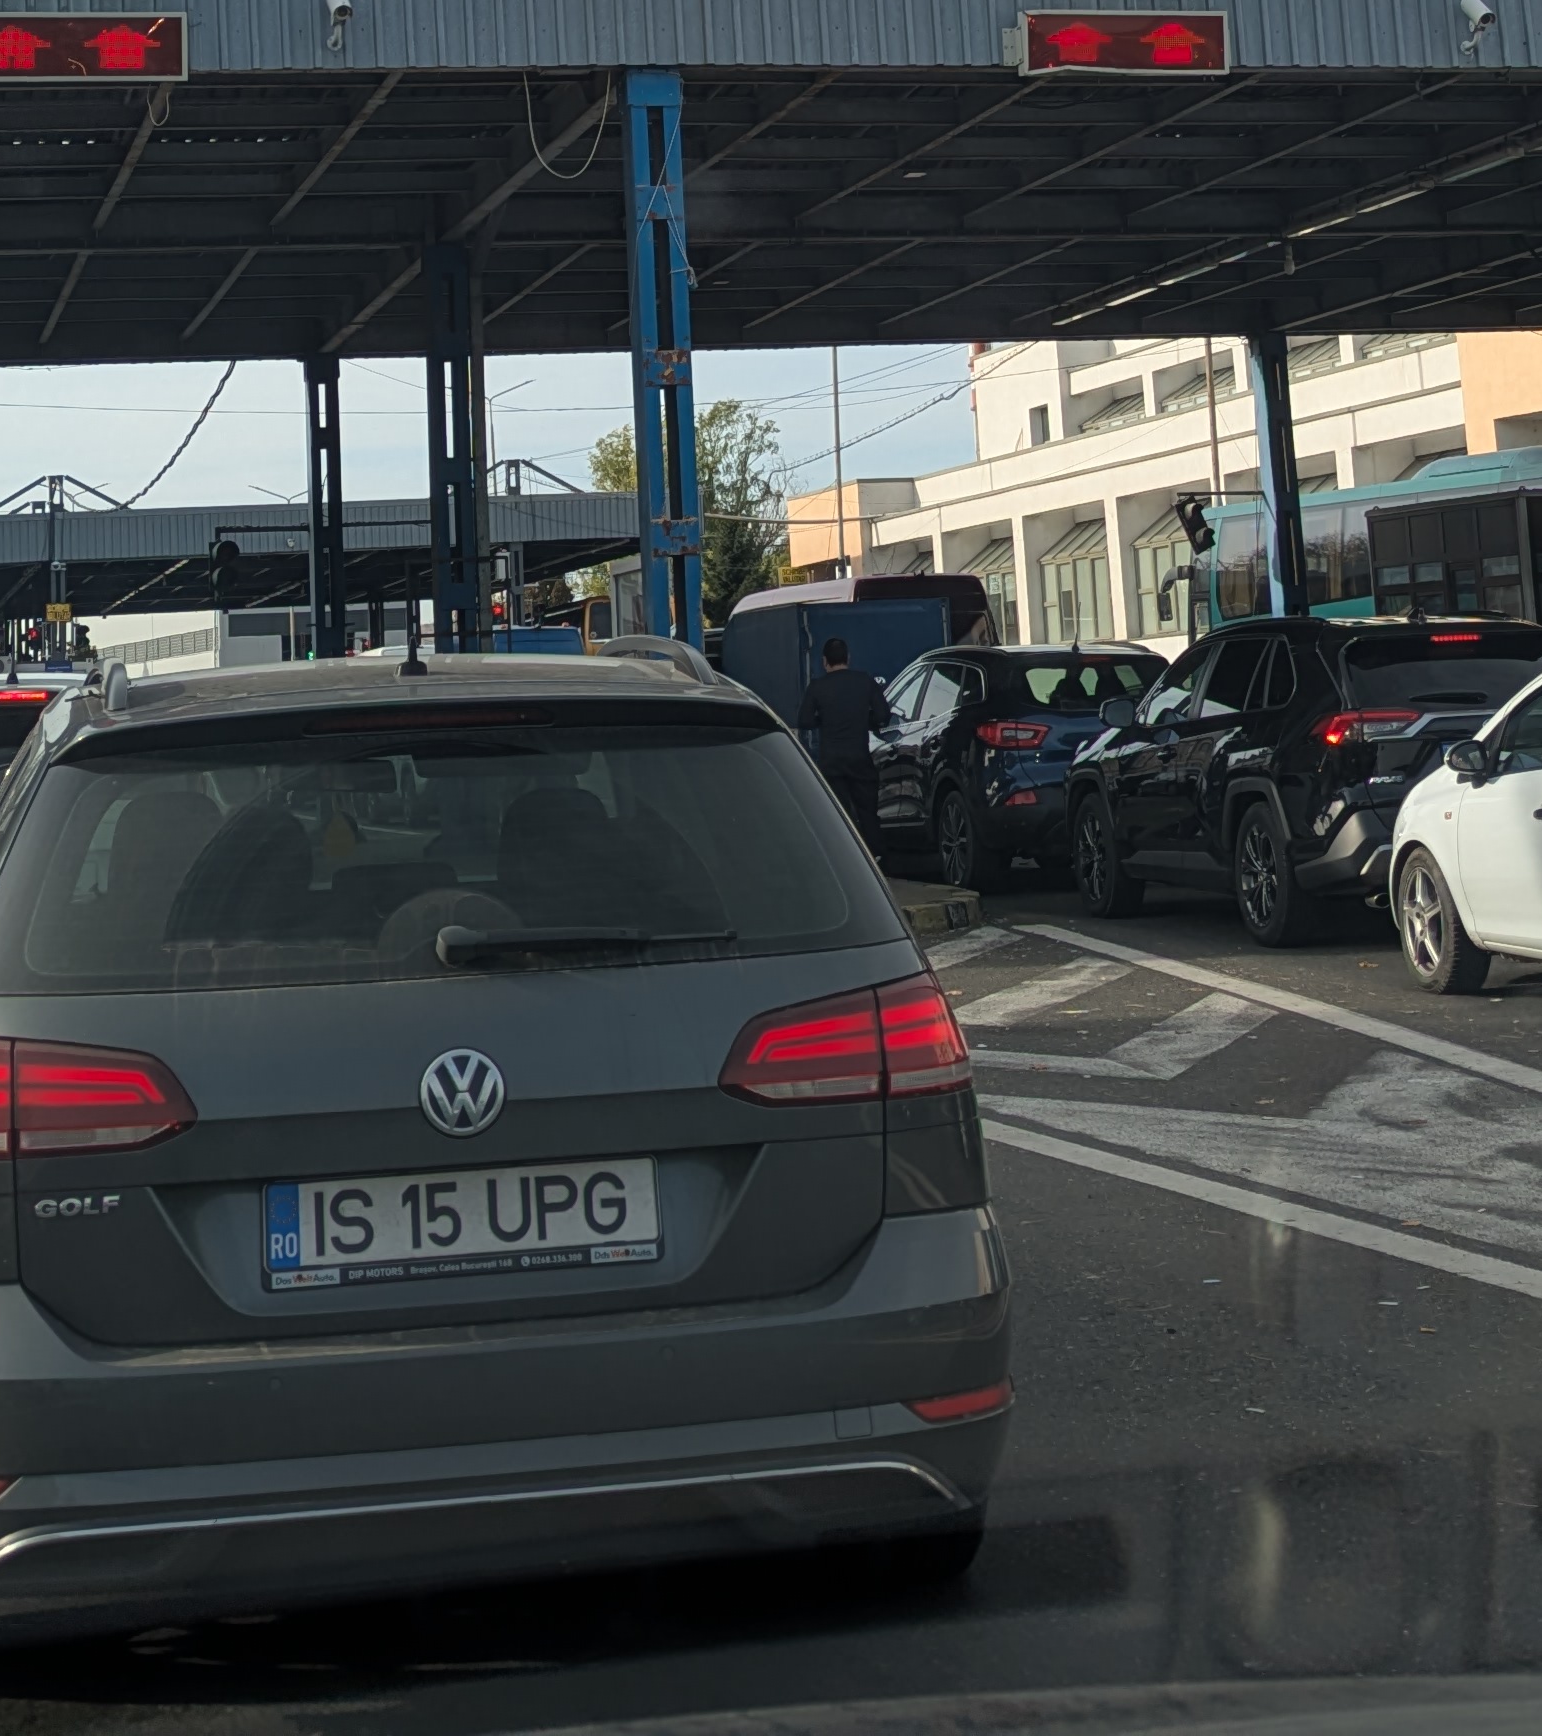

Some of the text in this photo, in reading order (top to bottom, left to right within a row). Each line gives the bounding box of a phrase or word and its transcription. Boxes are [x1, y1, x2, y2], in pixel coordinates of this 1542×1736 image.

[34, 1194, 121, 1218] GOLF
[313, 1171, 628, 1257] IS 15 UPG
[270, 1232, 299, 1259] RO
[348, 1270, 364, 1280] DIP
[366, 1267, 404, 1278] MOTORS
